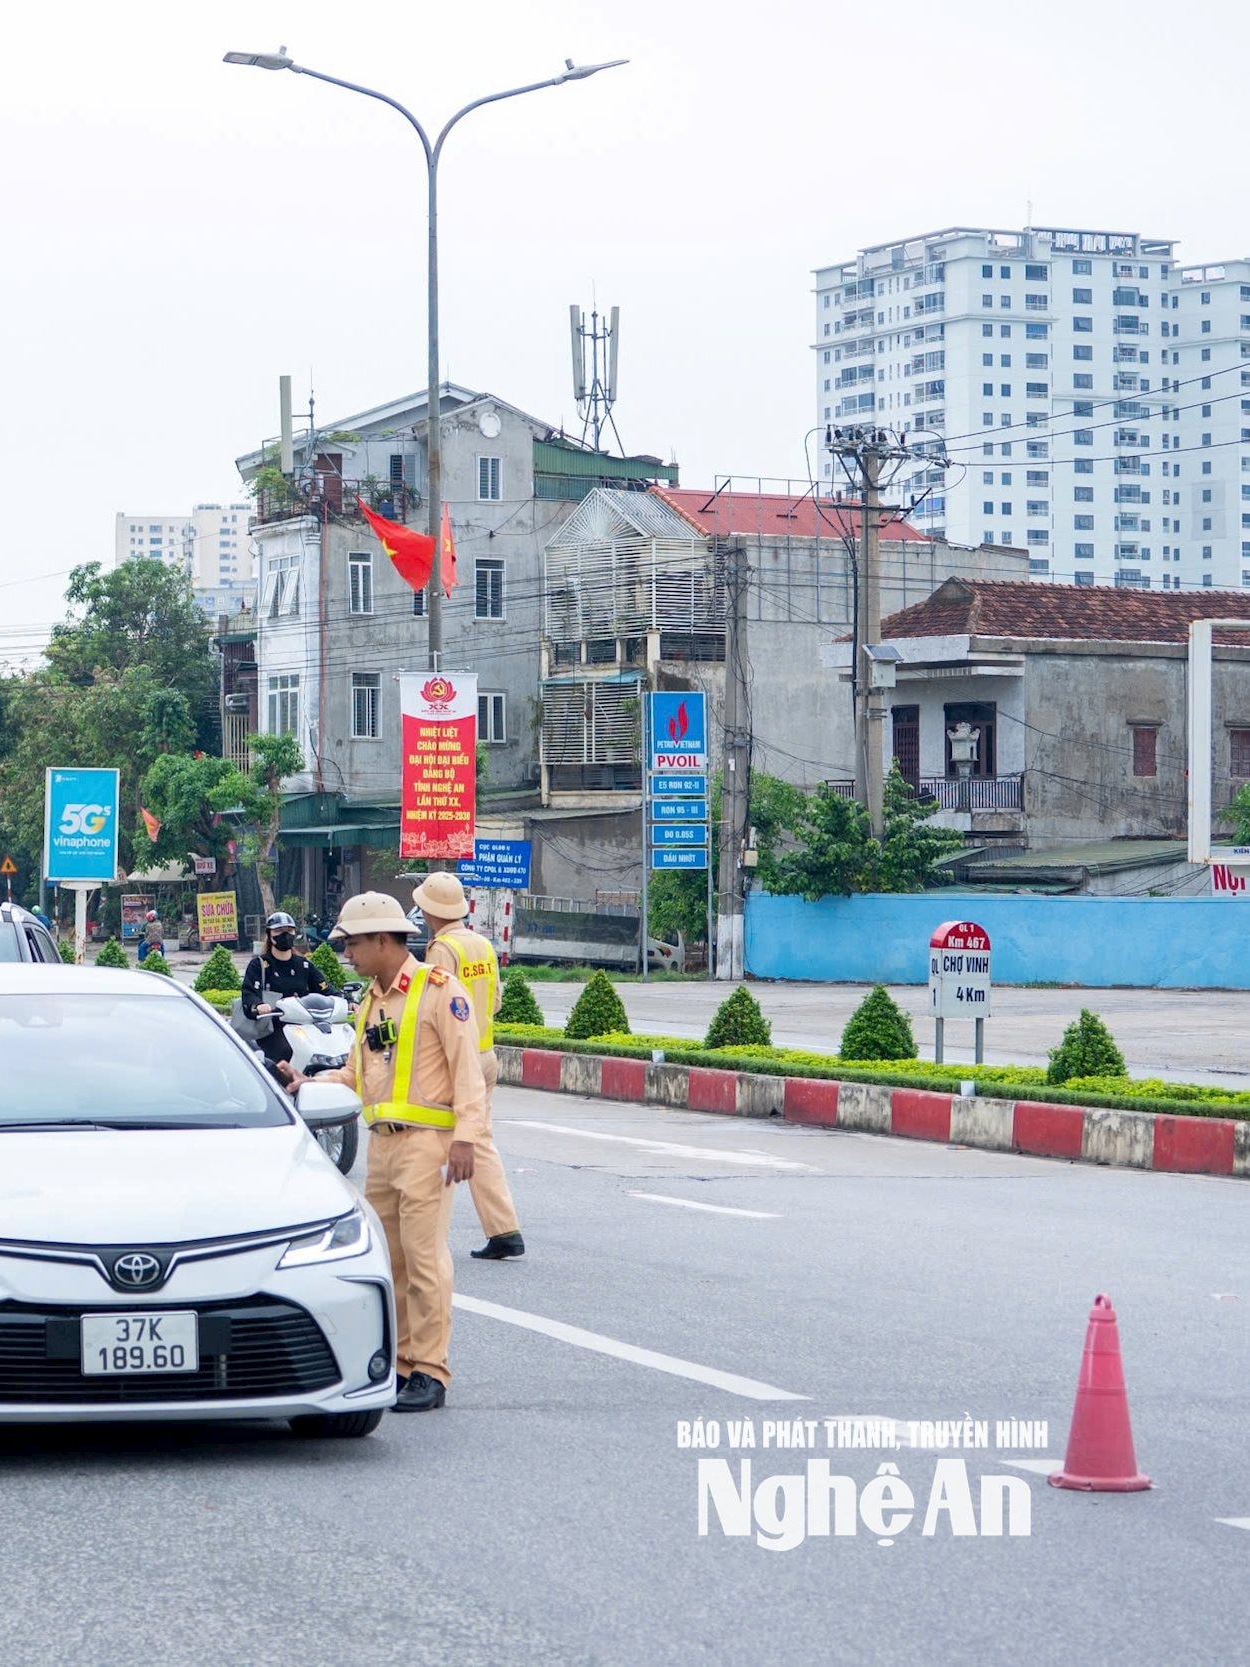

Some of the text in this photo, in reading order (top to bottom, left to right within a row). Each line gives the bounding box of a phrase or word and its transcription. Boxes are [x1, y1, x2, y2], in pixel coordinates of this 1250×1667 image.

[420, 726, 459, 739] NHIỆT LIỆT
[417, 740, 461, 751] CHÀO MỪNG
[409, 752, 469, 767] ĐẠI HỘI ĐẠI BIỂU
[657, 755, 701, 767] PVOIL
[422, 766, 455, 780] ĐẢNG BỘ
[414, 780, 464, 794] TỈNH NGHỆ AN
[658, 781, 667, 789] E5
[668, 781, 683, 789] RON
[433, 795, 448, 806] THỨ
[438, 811, 470, 820] 2025-2030
[661, 806, 676, 814] RON
[676, 806, 685, 814] 95
[53, 835, 111, 849] vinaphone
[478, 852, 522, 864] PHẬN QUẢN LÝ
[460, 863, 476, 872] CÔNG
[202, 900, 234, 917] SỬA CHỮA
[959, 924, 974, 932] QL 1
[948, 935, 985, 949] Km 467
[943, 955, 989, 975] CHỢ VINH
[956, 986, 985, 1002] 4 Km
[116, 1318, 164, 1342] 37K
[99, 1344, 185, 1371] 189.60
